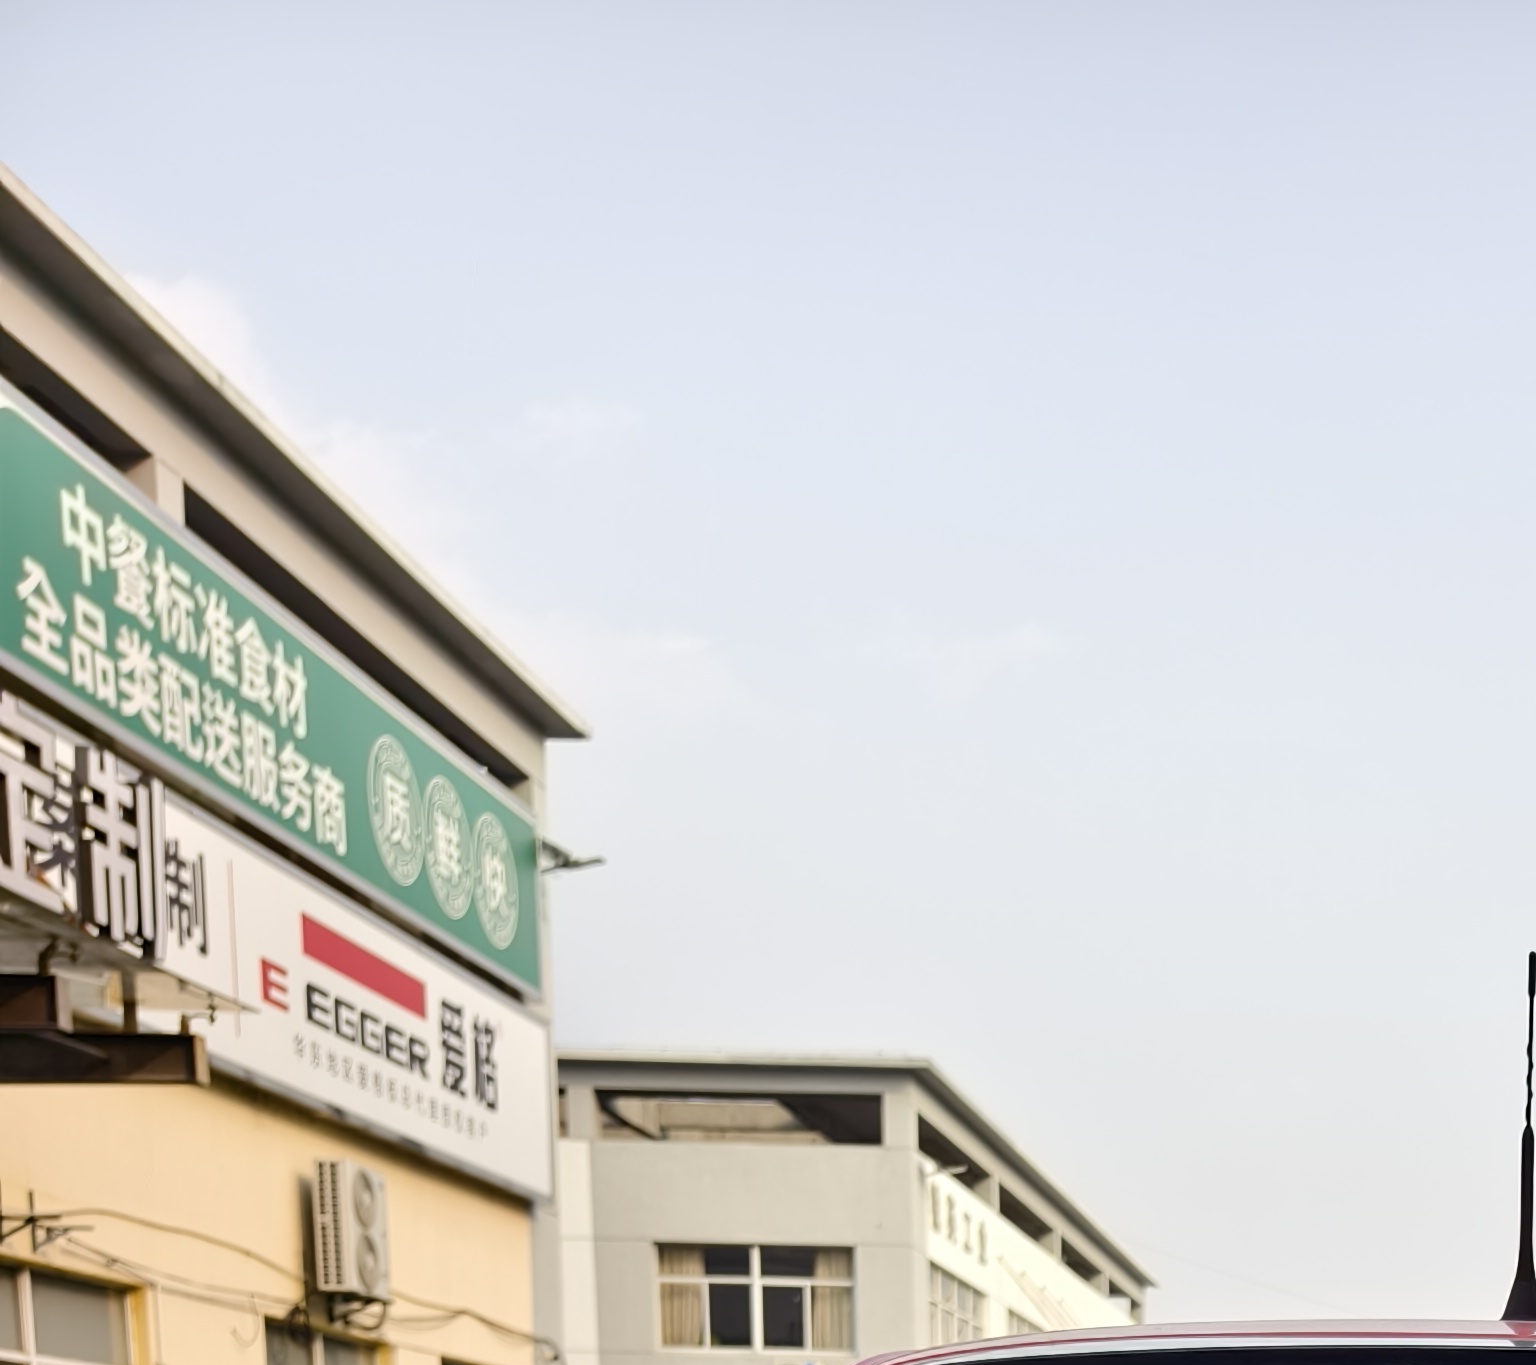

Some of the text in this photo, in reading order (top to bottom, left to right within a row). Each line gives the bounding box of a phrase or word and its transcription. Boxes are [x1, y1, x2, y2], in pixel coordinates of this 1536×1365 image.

[17, 556, 347, 856] 全品类配送服务商
[61, 484, 307, 739] 中餐标准食材
[260, 957, 290, 1012] E
[306, 982, 429, 1079] EGGER
